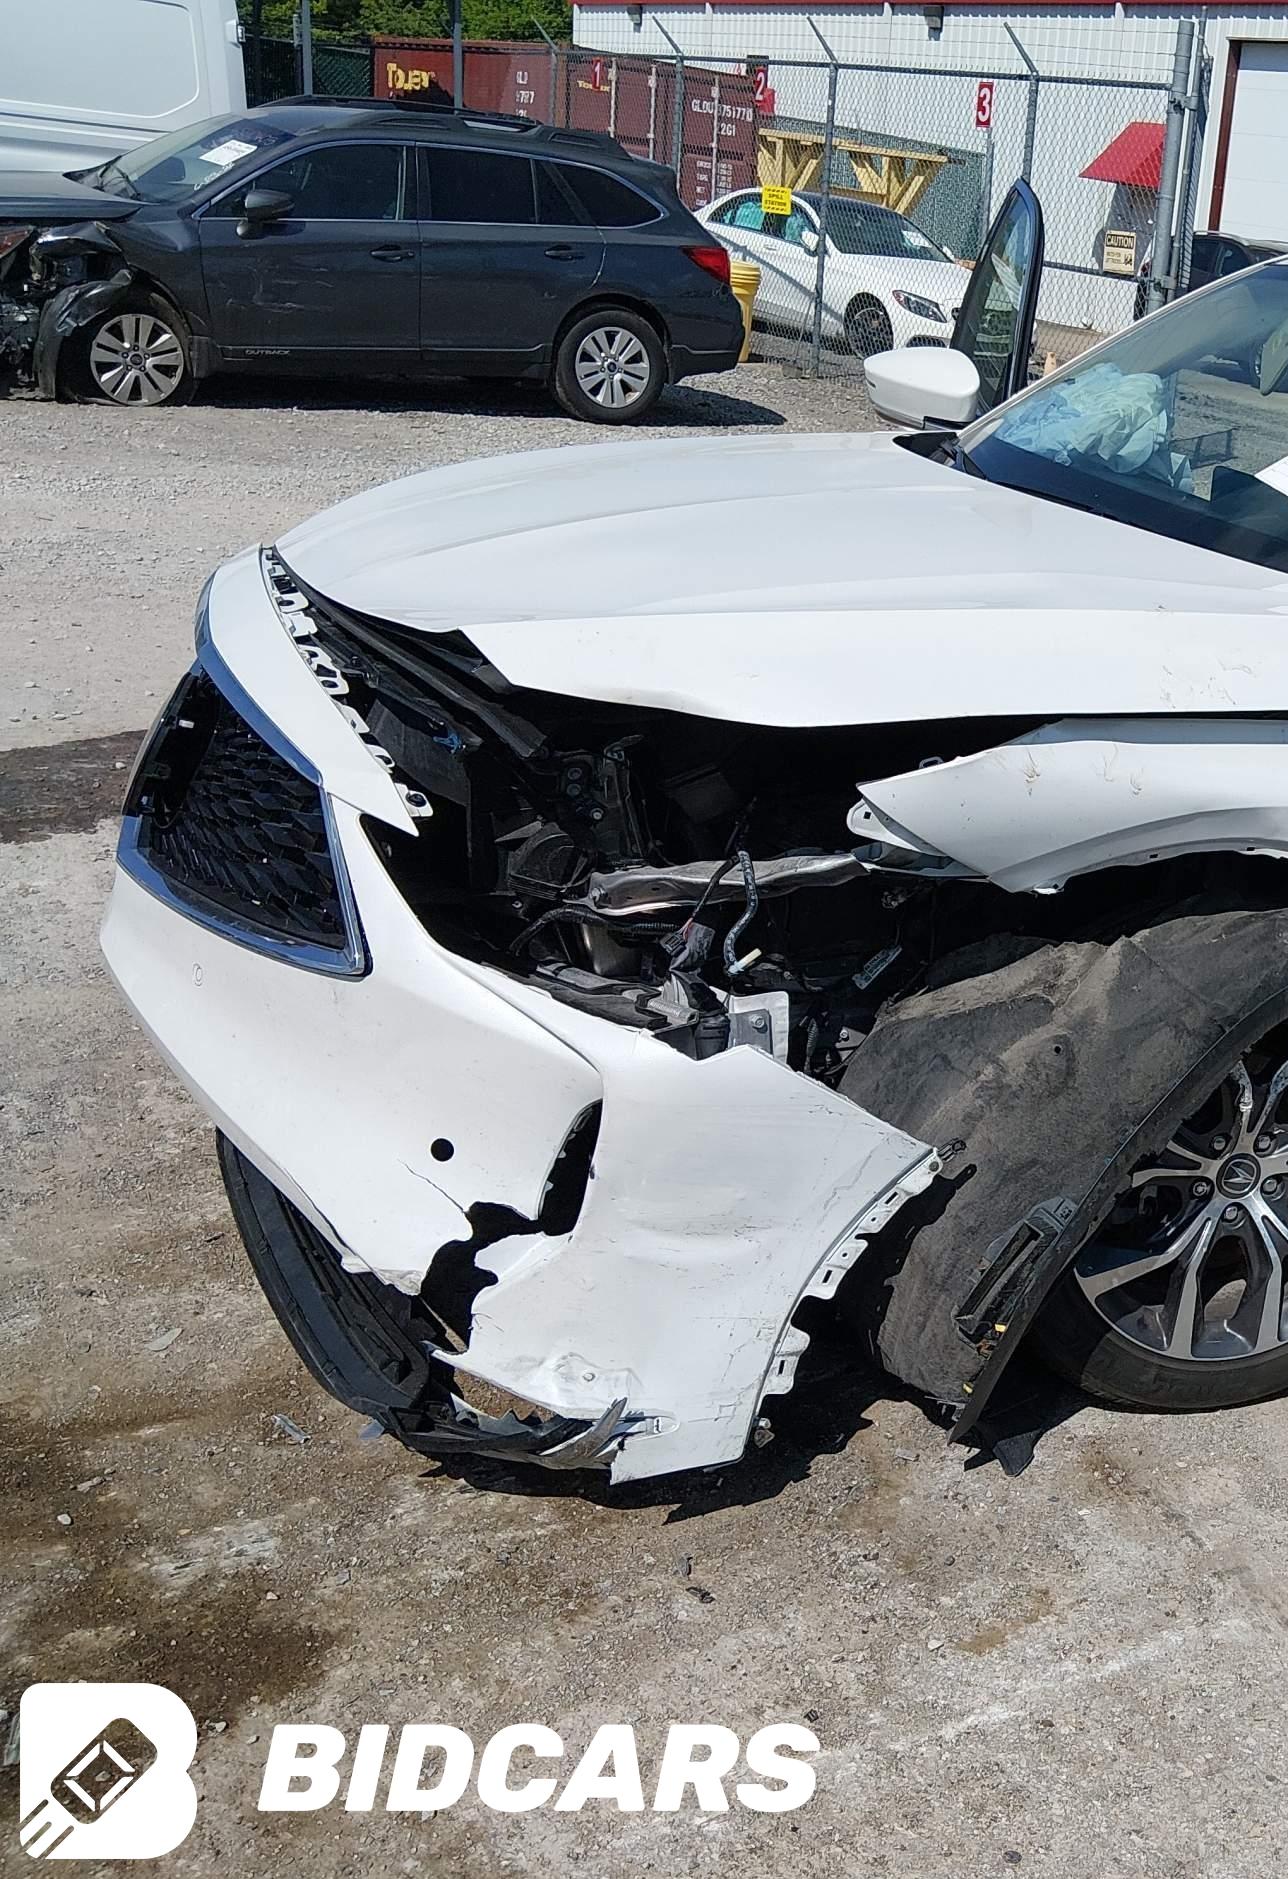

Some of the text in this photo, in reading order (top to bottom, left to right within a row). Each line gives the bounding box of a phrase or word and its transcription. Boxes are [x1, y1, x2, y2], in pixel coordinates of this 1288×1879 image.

[755, 71, 765, 101] 2
[977, 87, 991, 123] 3
[1106, 234, 1134, 249] CAUTION
